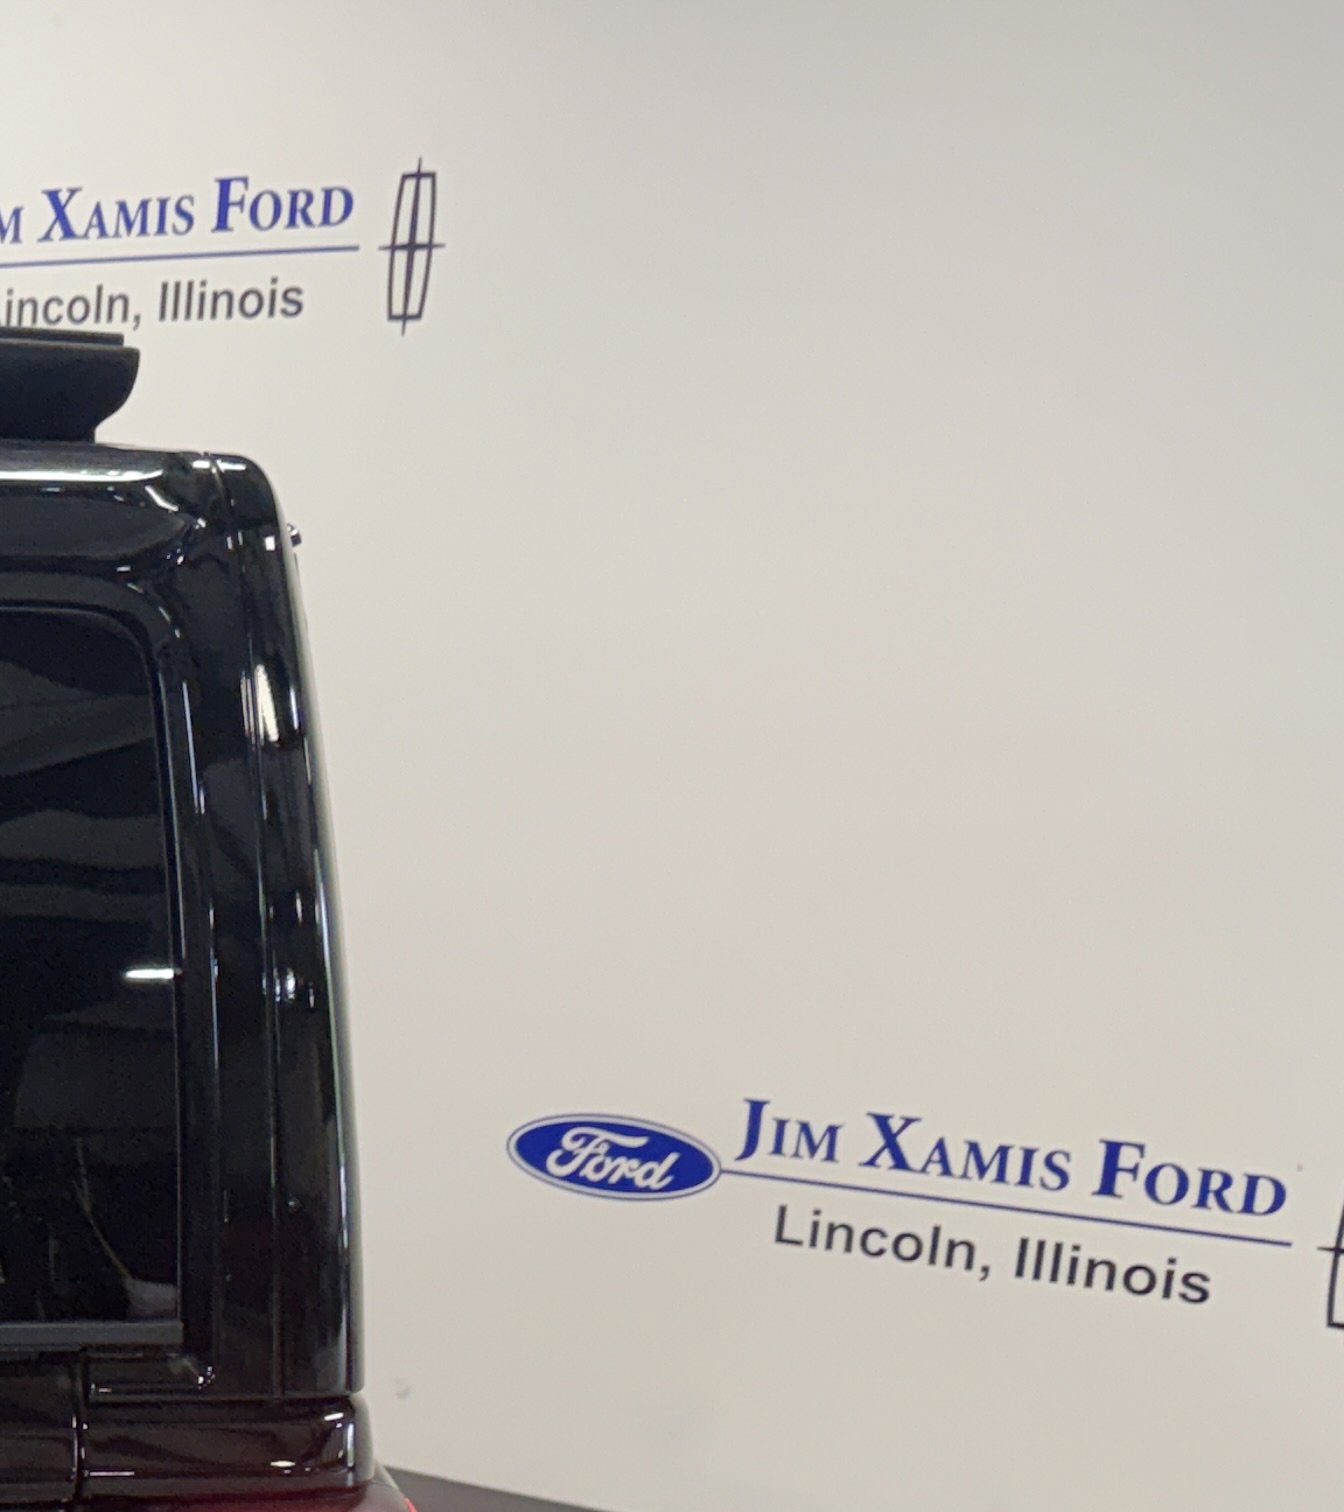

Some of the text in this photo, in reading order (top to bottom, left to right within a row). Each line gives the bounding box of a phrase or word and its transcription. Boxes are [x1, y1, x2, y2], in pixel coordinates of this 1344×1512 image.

[37, 187, 196, 243] XAMIS
[211, 176, 354, 233] FORD
[158, 277, 304, 321] Illinois
[545, 1127, 679, 1193] Ford
[733, 1097, 1288, 1217] JIM XAMIS FORD
[773, 1204, 1211, 1305] Lincoln, Illinois
